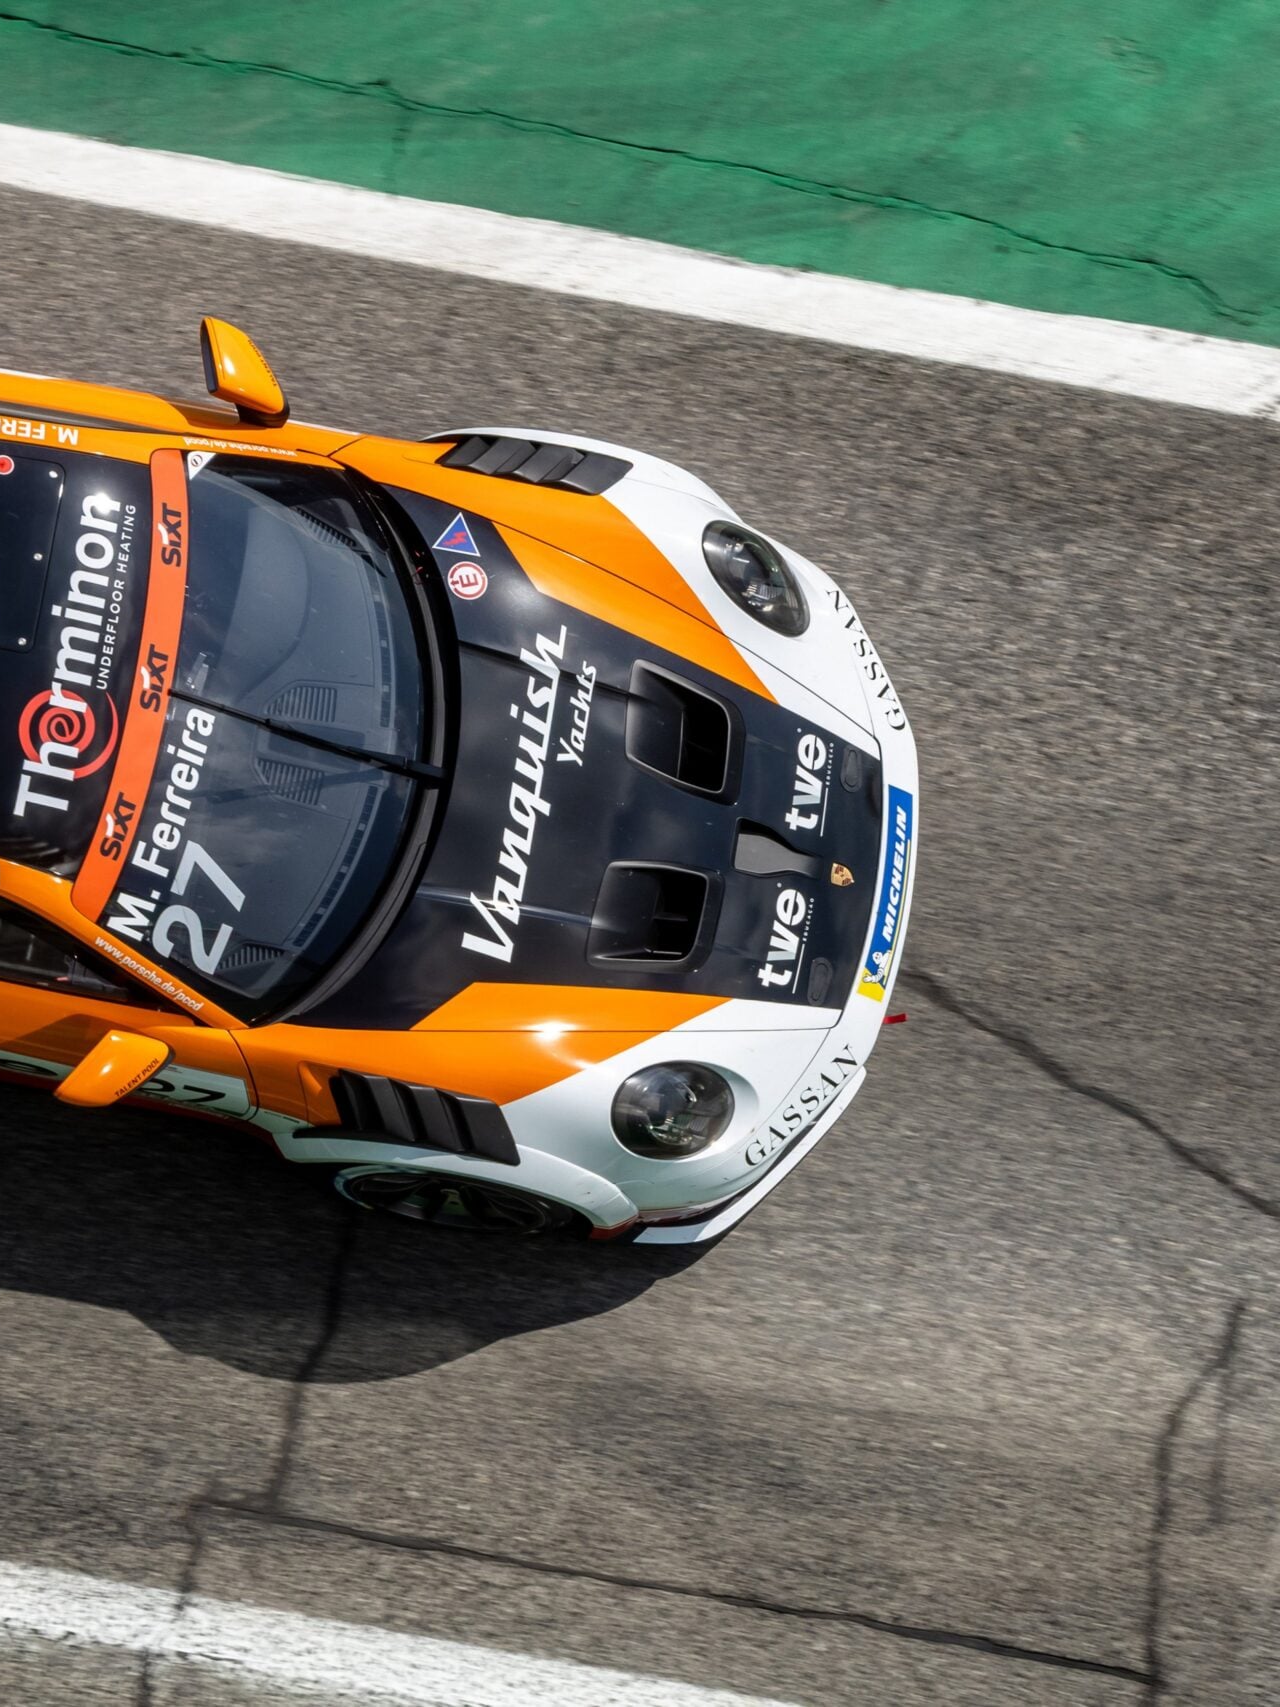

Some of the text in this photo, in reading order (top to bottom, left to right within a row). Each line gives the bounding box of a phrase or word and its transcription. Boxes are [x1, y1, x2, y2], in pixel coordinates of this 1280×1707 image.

[52, 425, 79, 446] M.
[96, 504, 137, 691] UNDERFLOOR HEATING
[556, 660, 597, 767] Yachts
[826, 590, 906, 731] GASSAN
[106, 707, 216, 942] M. Ferreira
[461, 625, 567, 964] Vanquish
[784, 733, 827, 831] tve
[151, 839, 247, 976] 27
[881, 805, 908, 943] MICHELIN
[94, 934, 205, 1013] www.porsche.de/pccd
[757, 888, 807, 988] tve
[114, 1074, 142, 1097] TALENT
[141, 1058, 160, 1077] POOL
[744, 1043, 859, 1167] GASSAN
